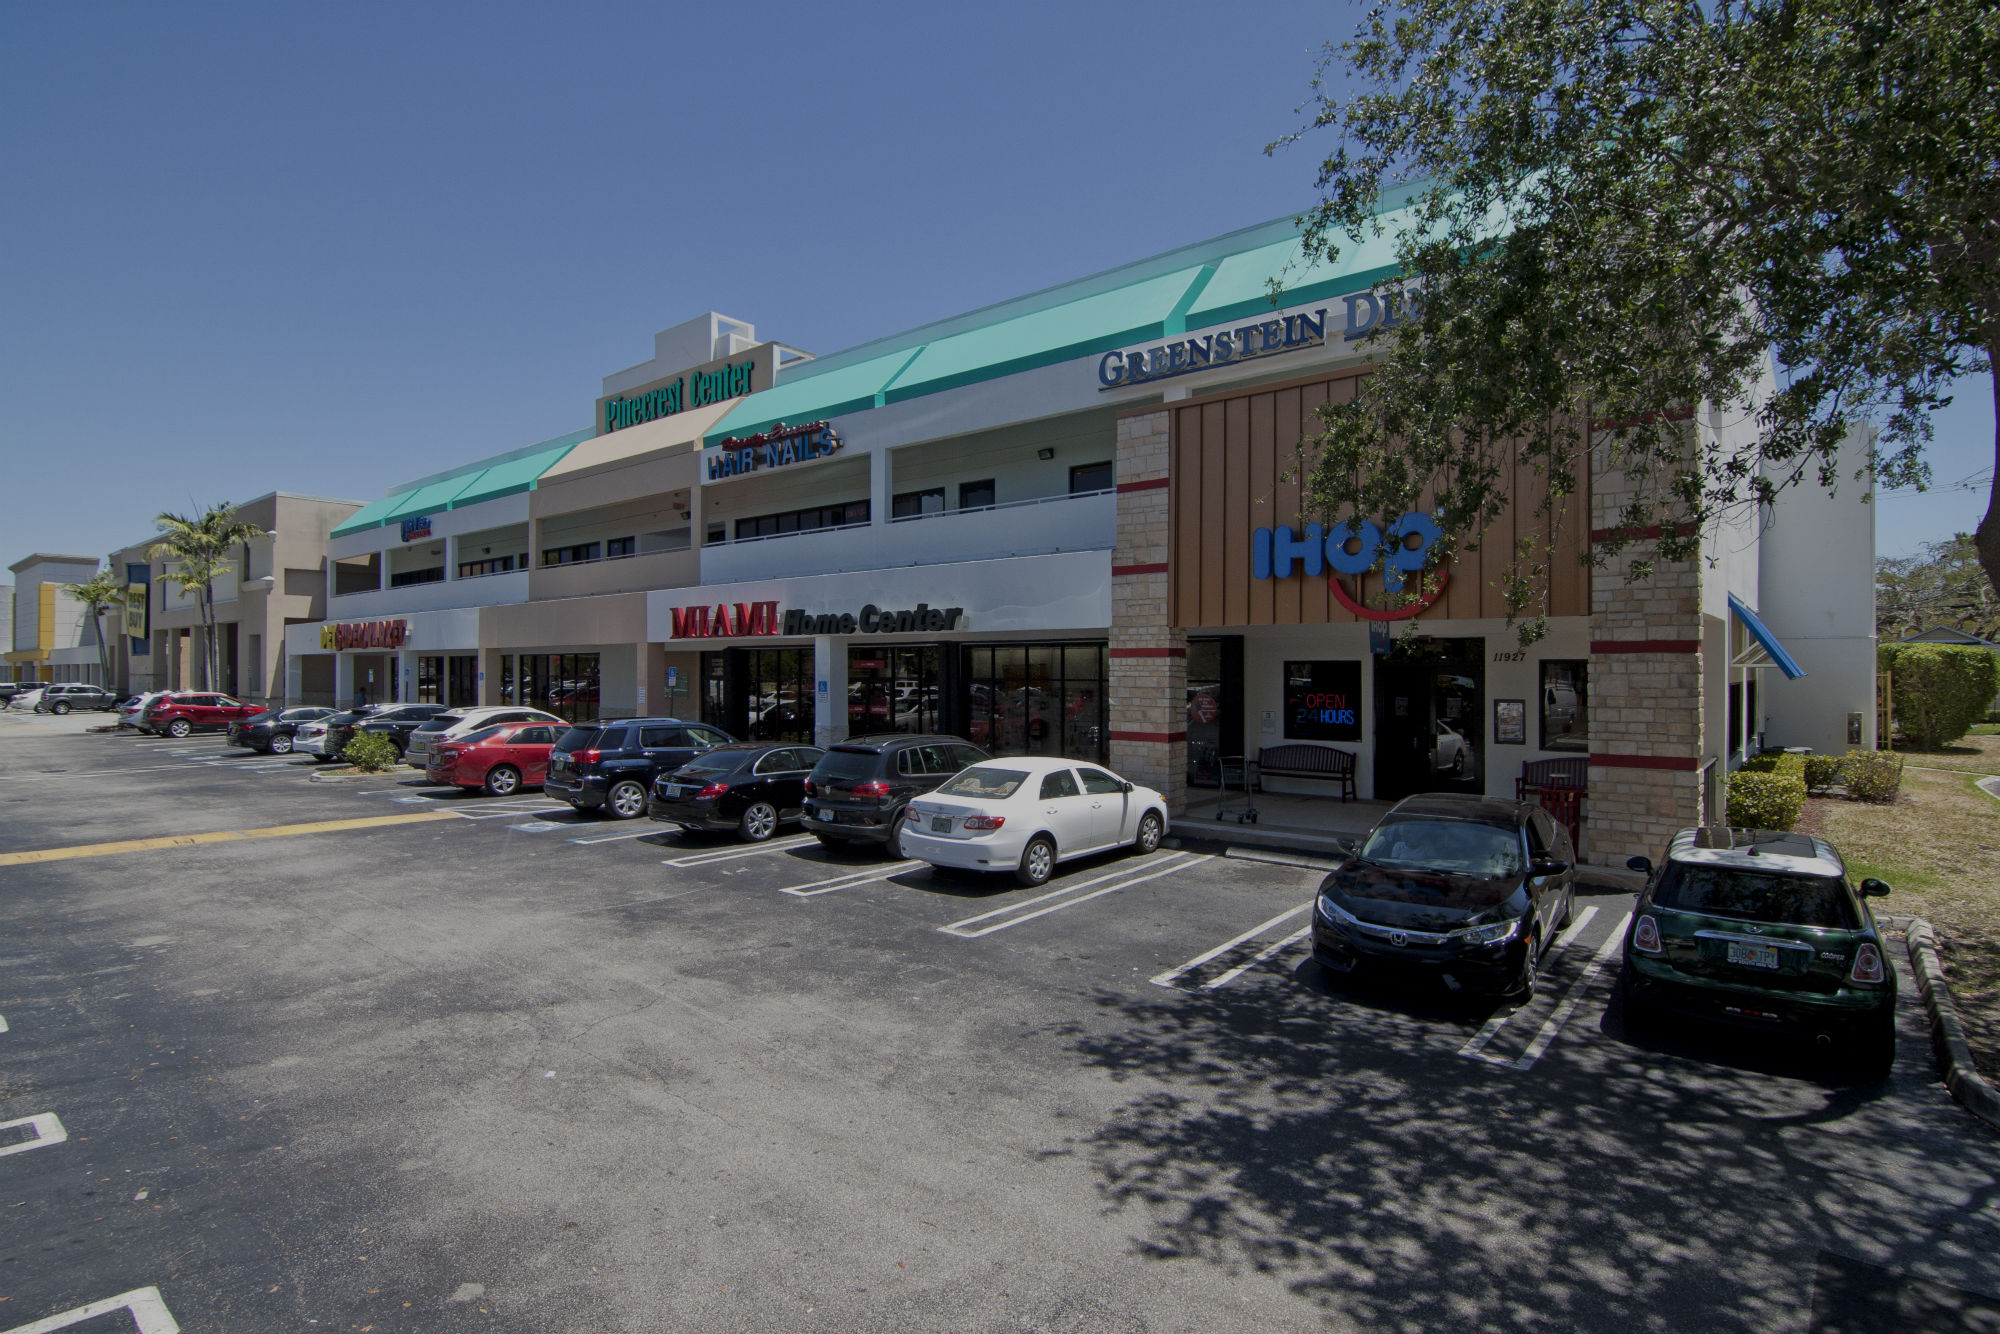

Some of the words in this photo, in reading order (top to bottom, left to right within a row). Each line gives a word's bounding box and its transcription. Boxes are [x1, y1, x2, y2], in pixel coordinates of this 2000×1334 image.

[1098, 308, 1328, 387] GREENSTEIN
[604, 377, 683, 434] Pinecrest
[690, 360, 755, 408] Center
[707, 446, 756, 480] HAIR
[766, 428, 837, 468] NAILS
[128, 591, 145, 611] BEST
[128, 611, 142, 629] BUY
[669, 600, 781, 639] MIAMI
[783, 608, 856, 636] Home
[859, 603, 964, 635] Center
[1493, 652, 1527, 662] 11927
[1305, 693, 1346, 709] OPEN
[1296, 708, 1319, 725] 24
[1320, 708, 1356, 726] HOURS
